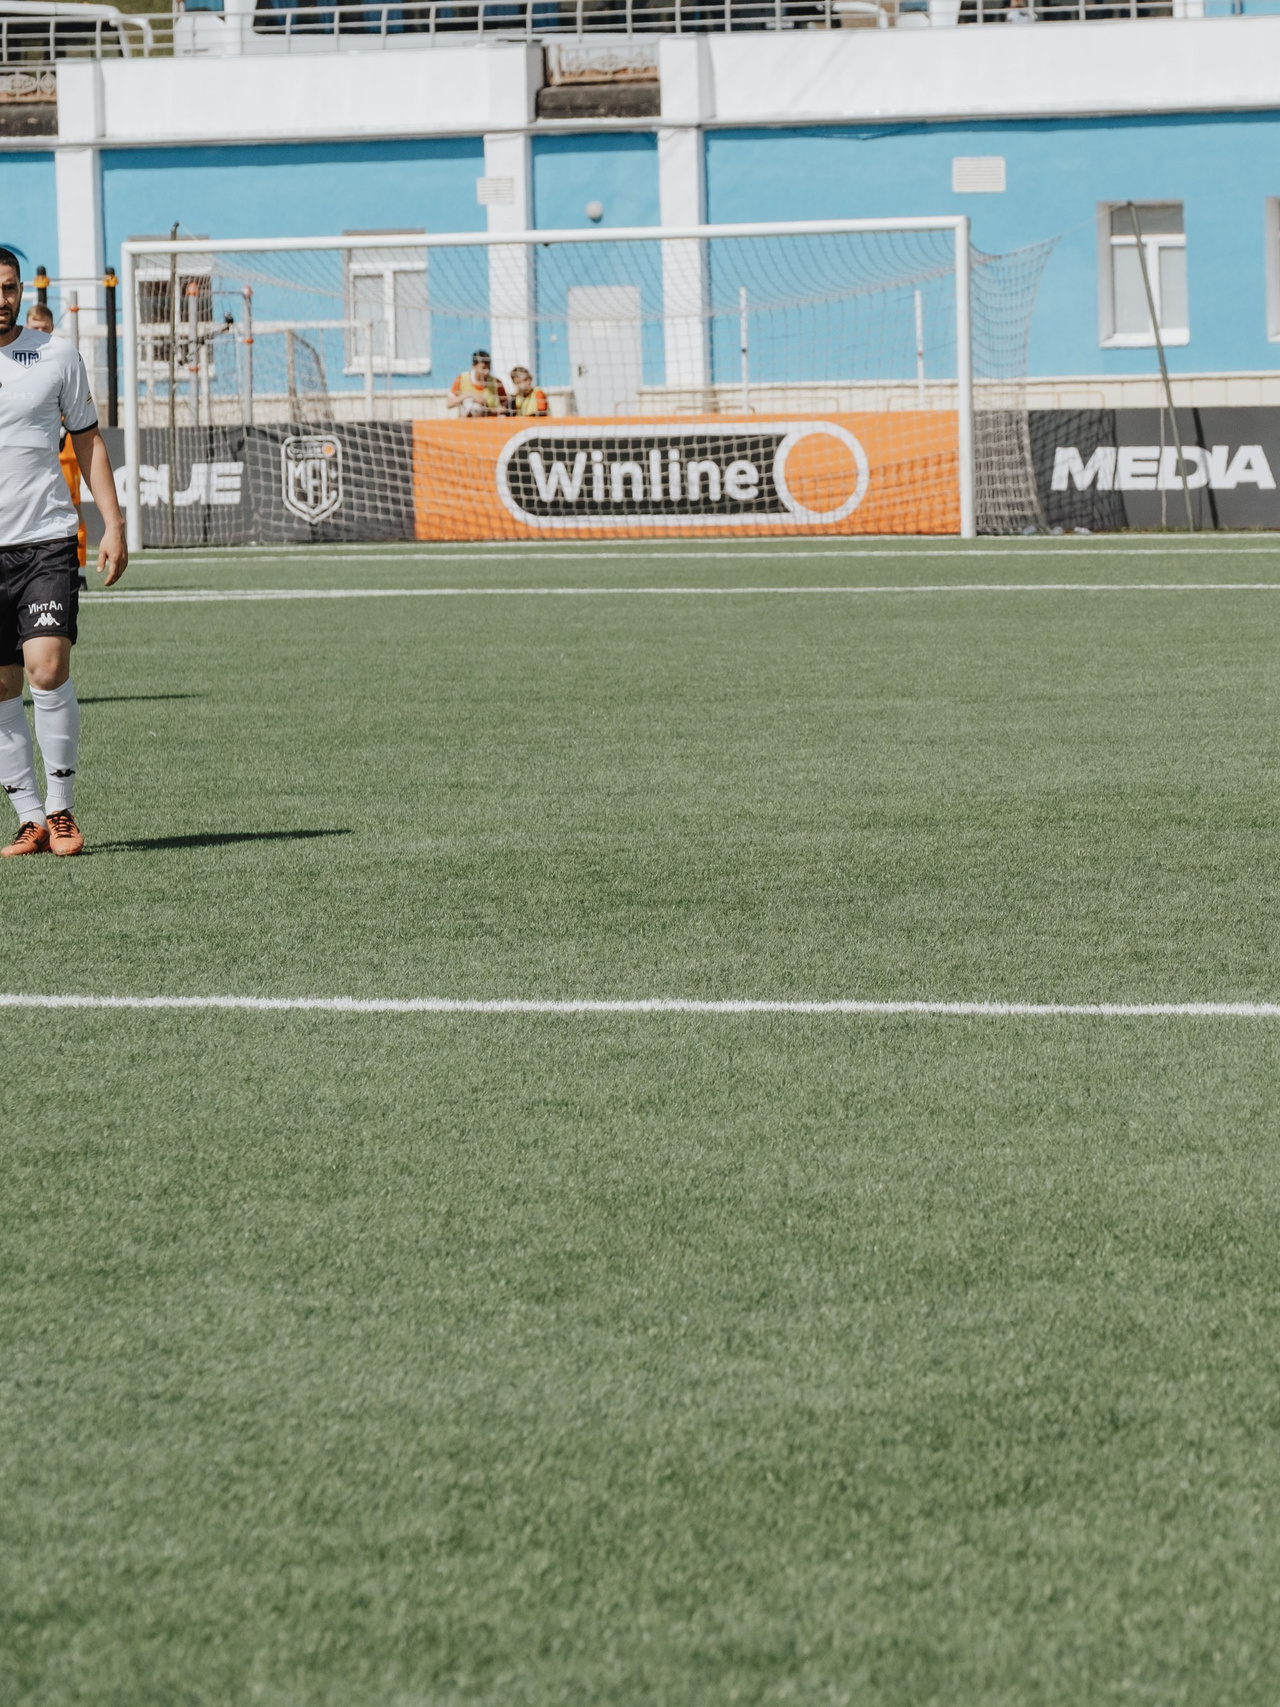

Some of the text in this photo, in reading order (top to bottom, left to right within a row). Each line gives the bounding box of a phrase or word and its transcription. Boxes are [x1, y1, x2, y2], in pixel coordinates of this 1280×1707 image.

[81, 461, 244, 507] GUE
[528, 448, 760, 503] Winline
[1050, 444, 1277, 492] MEDIA
